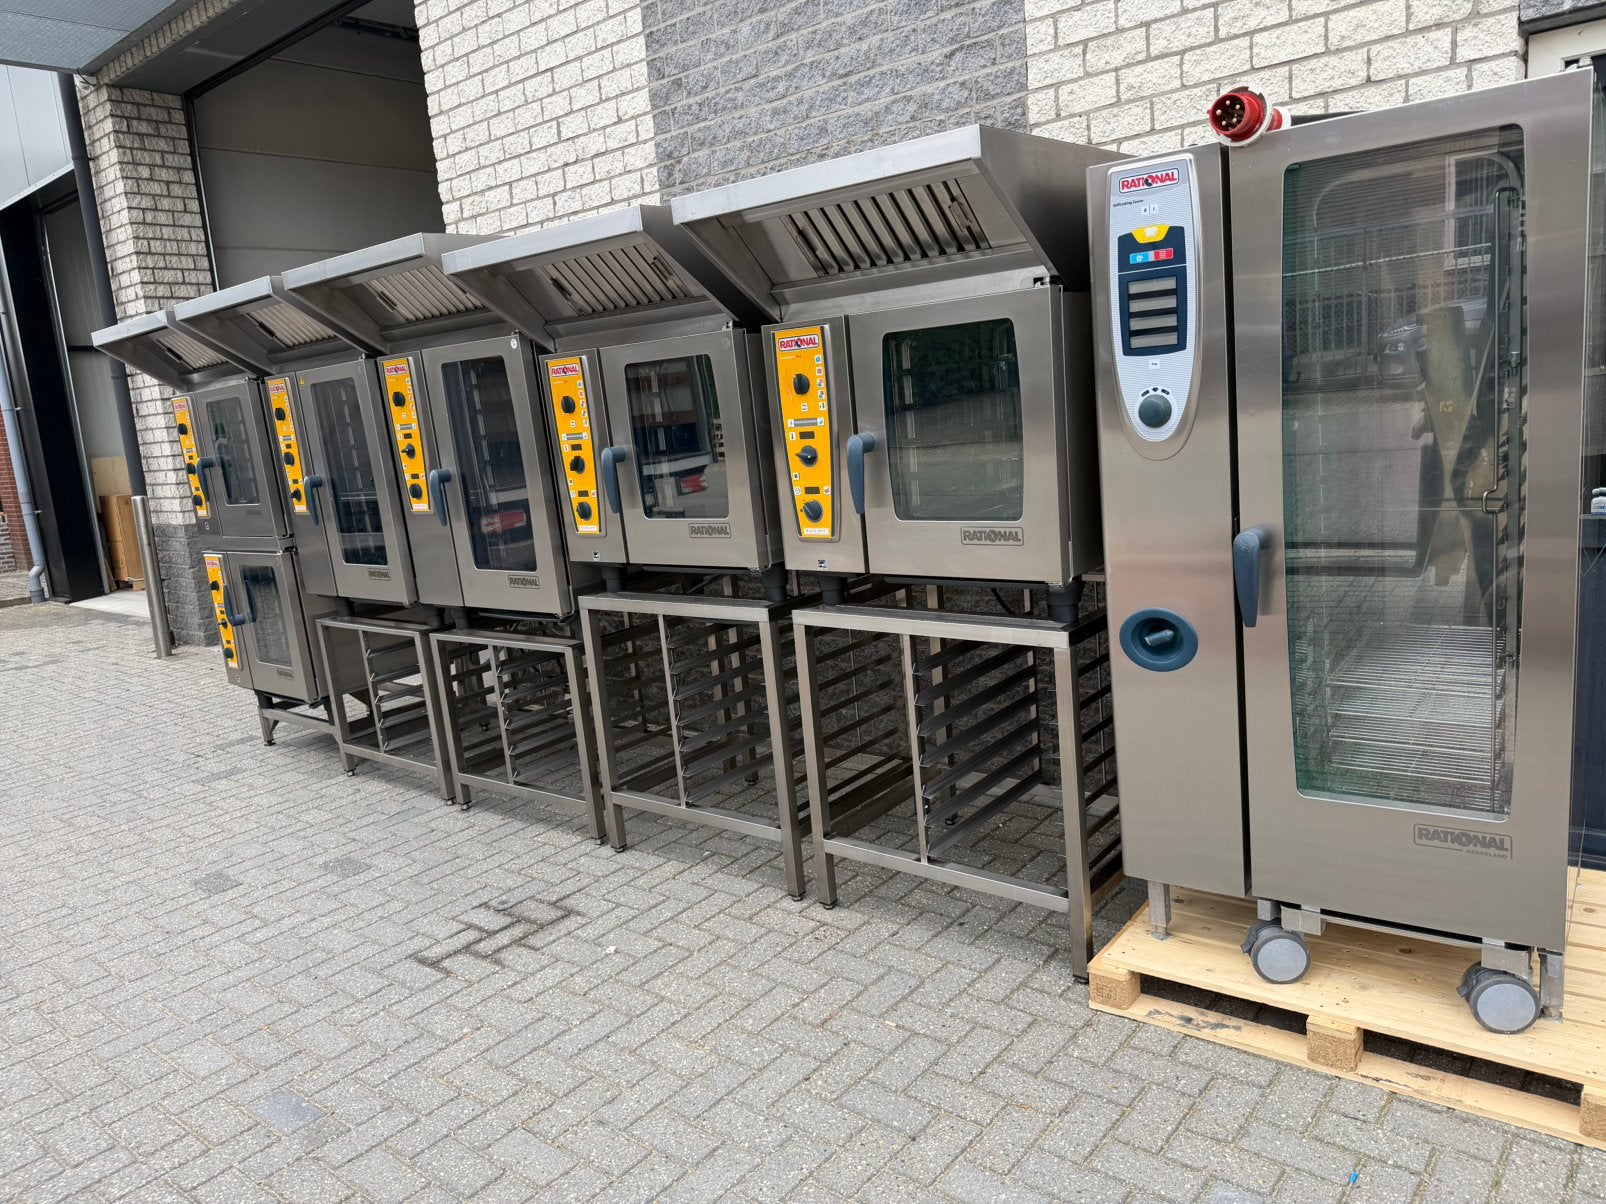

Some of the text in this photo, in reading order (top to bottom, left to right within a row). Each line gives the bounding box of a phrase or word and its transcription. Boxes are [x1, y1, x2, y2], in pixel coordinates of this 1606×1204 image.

[1121, 171, 1178, 191] RATIONAL
[780, 336, 818, 349] RATIONAL
[551, 364, 579, 376] RATIONAL
[690, 525, 730, 536] RATIONAL
[963, 529, 1022, 543] RATIONAL
[509, 577, 539, 587] RATIONAL
[1417, 826, 1509, 852] RATIONAL
